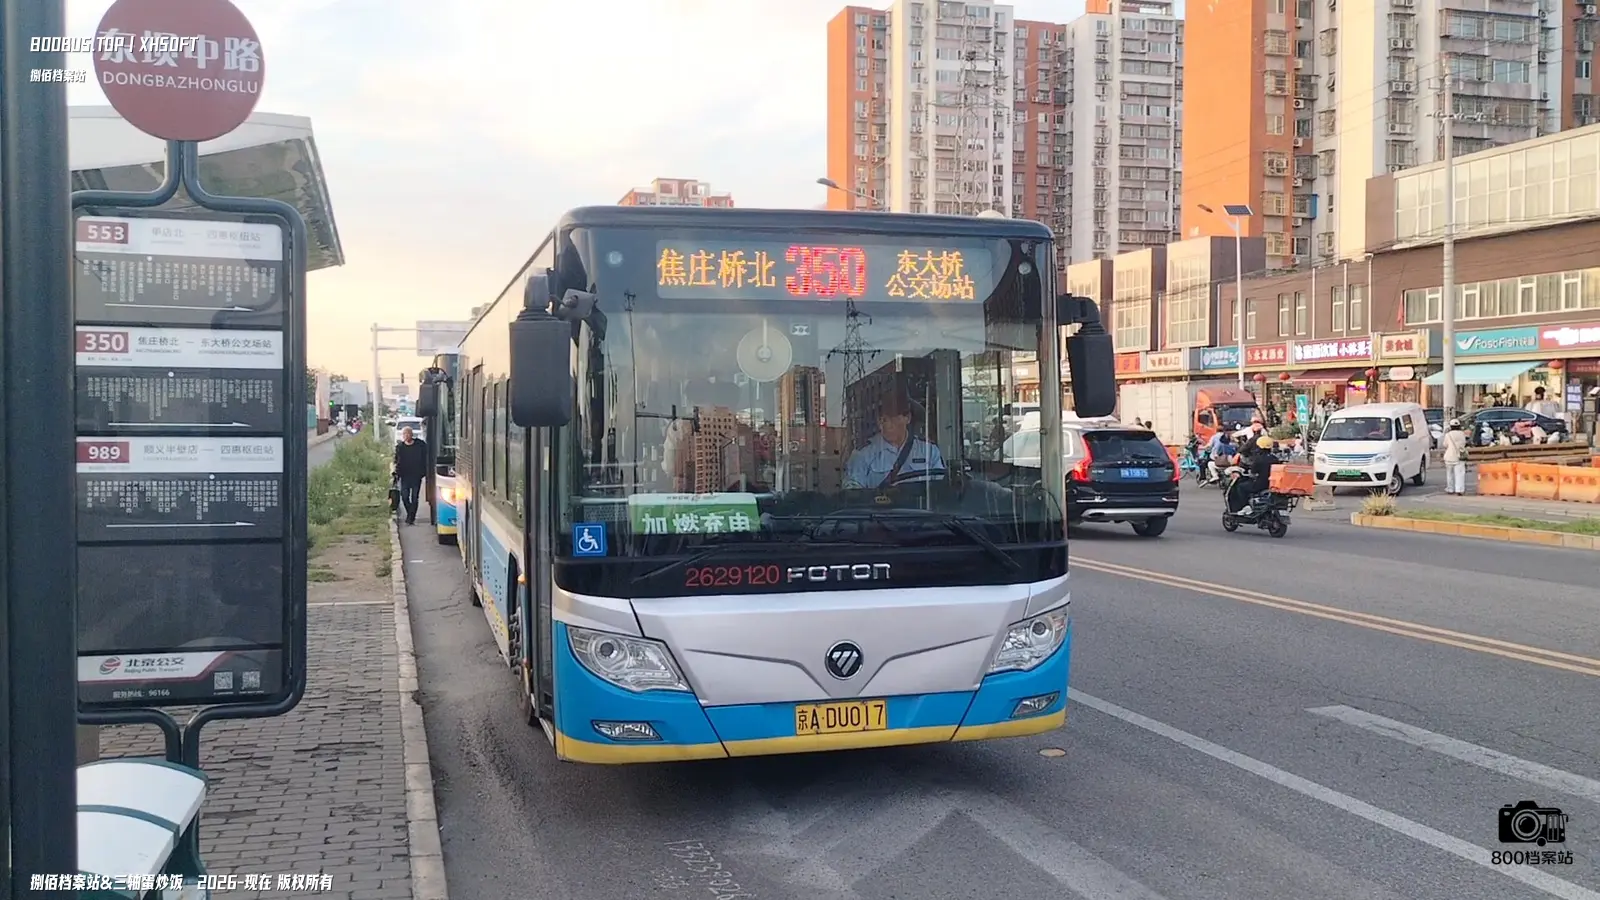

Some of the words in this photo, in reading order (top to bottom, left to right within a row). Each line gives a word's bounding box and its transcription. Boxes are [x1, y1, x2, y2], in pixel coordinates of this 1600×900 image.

[99, 28, 260, 72] 东坝中路
[102, 71, 258, 94] DONGBAZHONGLU
[88, 225, 125, 241] 553
[657, 248, 777, 288] 焦庄桥北
[785, 245, 866, 297] 350
[896, 249, 964, 277] 东大桥
[884, 274, 975, 300] 公交场站
[84, 333, 125, 351] 350
[138, 336, 180, 347] 焦庄桥北
[200, 337, 272, 348] 东大桥公交场站
[1298, 398, 1308, 422] 入口
[88, 445, 121, 461] 989
[143, 444, 198, 455] 顺义半壁店
[220, 444, 274, 455] 四惠枢纽站
[641, 512, 751, 535] 加燃充电
[685, 564, 780, 588] 2629120
[786, 562, 892, 583] FOTON
[125, 656, 185, 668] 北京公交
[148, 689, 170, 697] 96166
